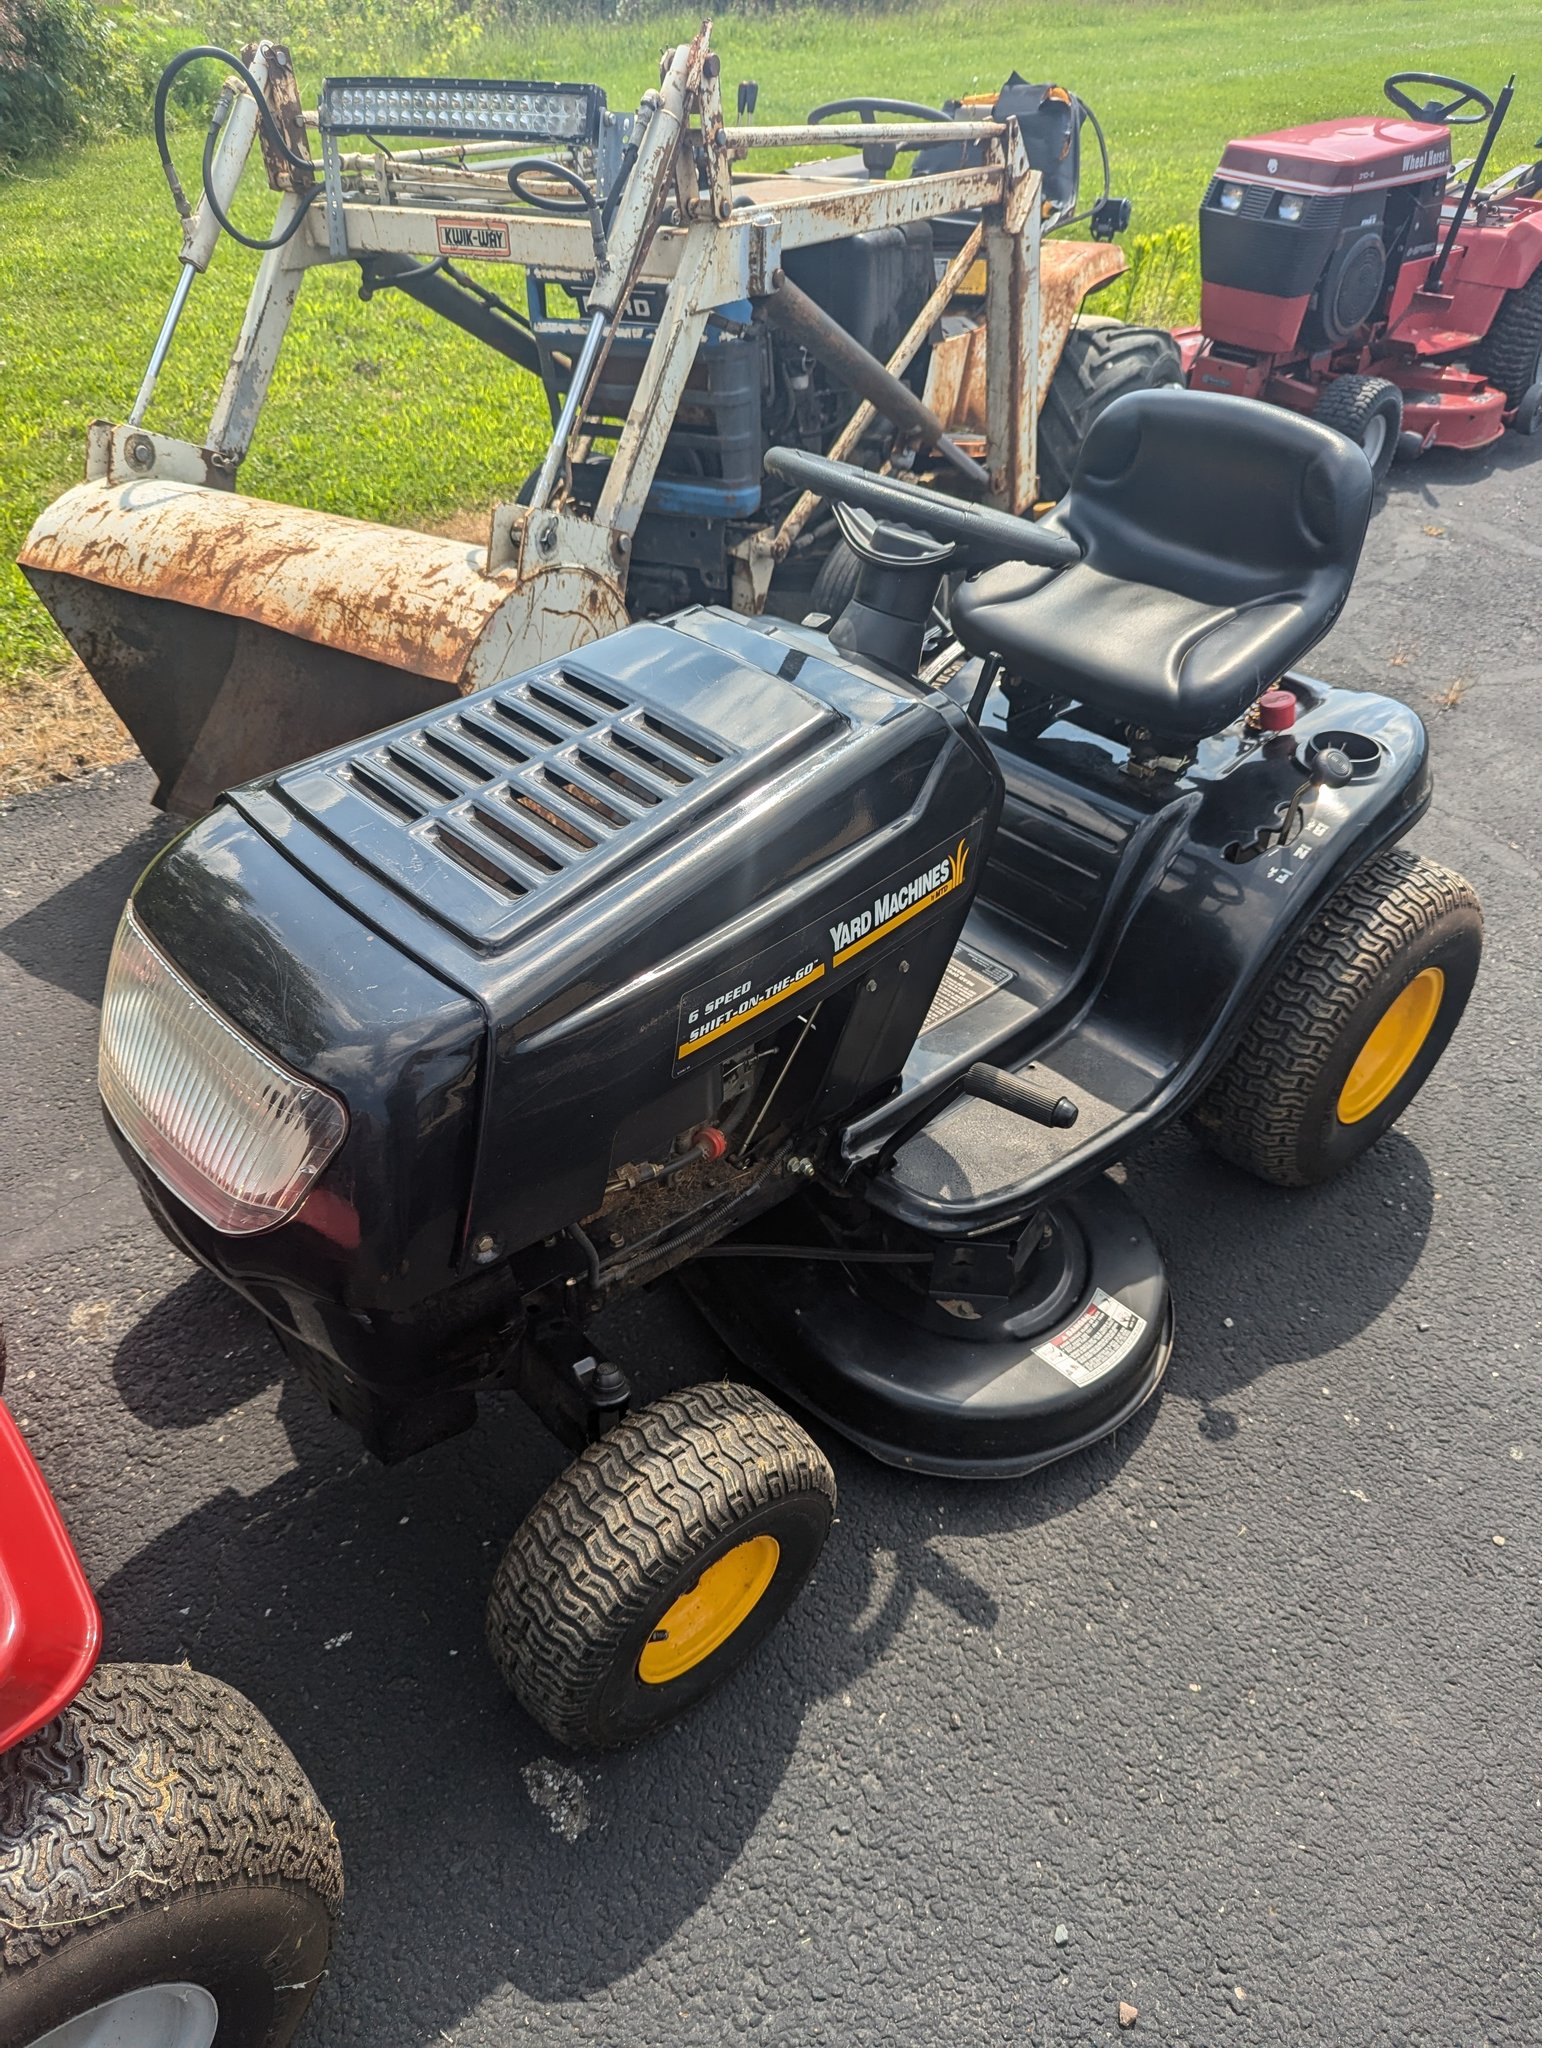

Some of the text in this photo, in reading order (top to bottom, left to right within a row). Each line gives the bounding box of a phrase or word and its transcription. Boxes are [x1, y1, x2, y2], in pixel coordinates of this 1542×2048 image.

[1402, 149, 1446, 172] Wheel Horse
[444, 228, 503, 248] KWIK-WAY
[829, 858, 950, 953] YARD MACHINES
[688, 980, 752, 1025] 6 SPEED
[689, 962, 814, 1043] SHIFT-ON-THE-GO
